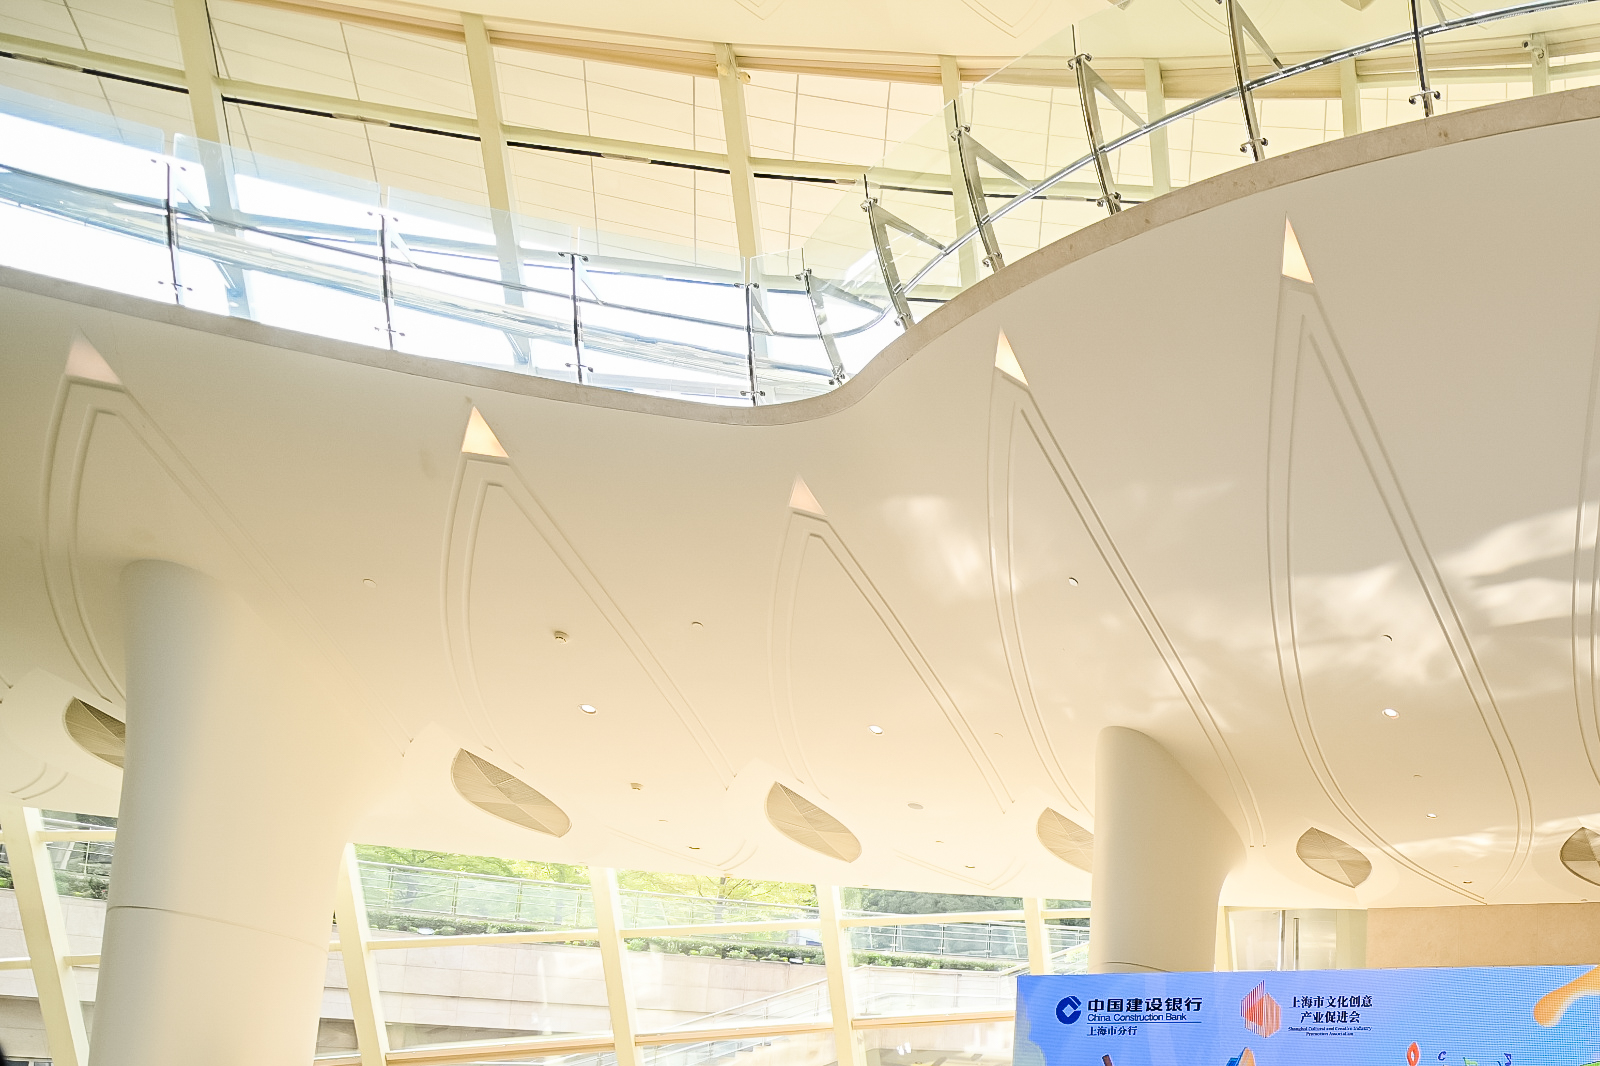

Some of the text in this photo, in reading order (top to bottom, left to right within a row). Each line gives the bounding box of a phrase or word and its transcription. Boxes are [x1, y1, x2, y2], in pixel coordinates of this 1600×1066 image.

[1087, 997, 1203, 1013] 中国建设银行
[1289, 995, 1373, 1008] 上海市文化创意
[1087, 1012, 1187, 1022] China Construction Bank
[1300, 1010, 1361, 1024] 产业促进会
[1086, 1025, 1138, 1036] 上海市分行
